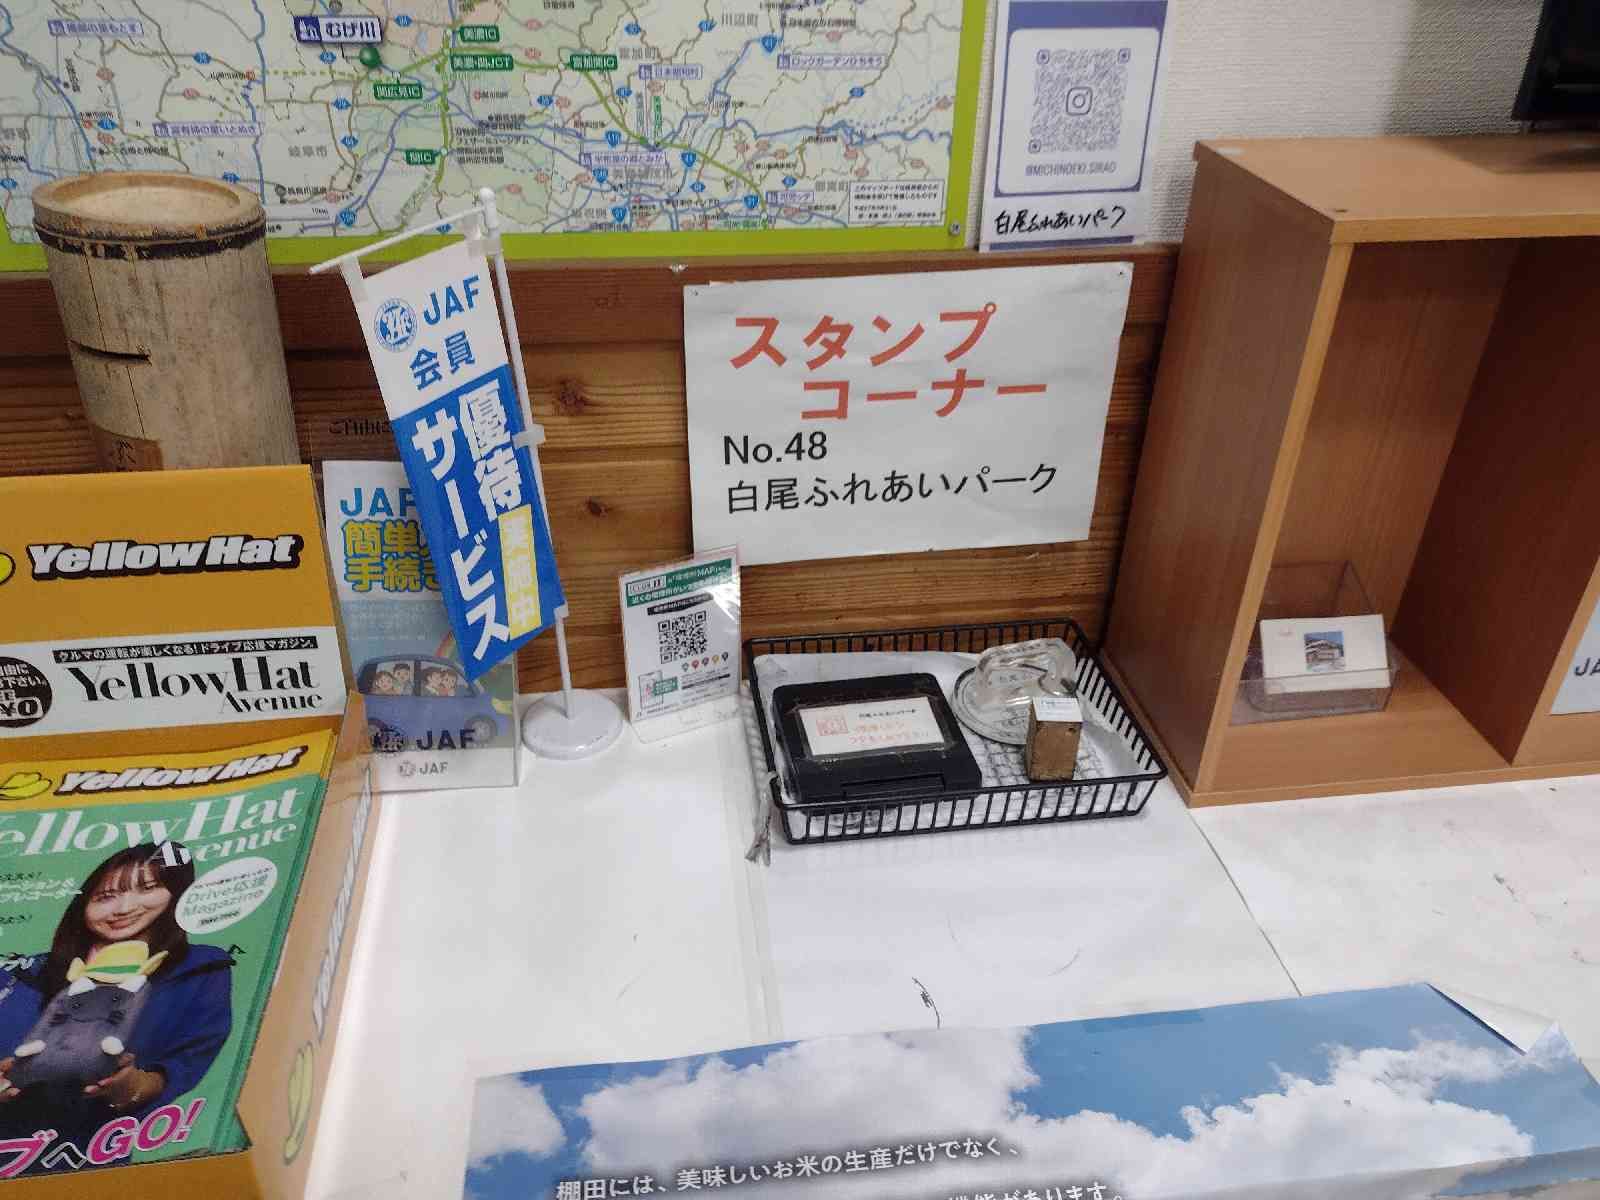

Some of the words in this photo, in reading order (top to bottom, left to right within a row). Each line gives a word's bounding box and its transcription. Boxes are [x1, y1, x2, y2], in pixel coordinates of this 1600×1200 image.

[325, 21, 377, 39] むげ川
[422, 275, 481, 326] JAF
[409, 330, 476, 391] 会員
[729, 301, 997, 370] スタンプ
[800, 368, 1048, 420] コーナー
[458, 378, 523, 522] 優待
[723, 431, 828, 466] No.48
[728, 463, 1058, 514] 白尾ふれあいパーク
[411, 407, 511, 661] サービス
[219, 691, 323, 714] Avenue
[415, 728, 477, 751] JAF
[419, 761, 450, 775] JAF
[148, 822, 298, 869] Avenue
[555, 1136, 1019, 1200] 棚田には、美味しいお米の生産だけでなく、
